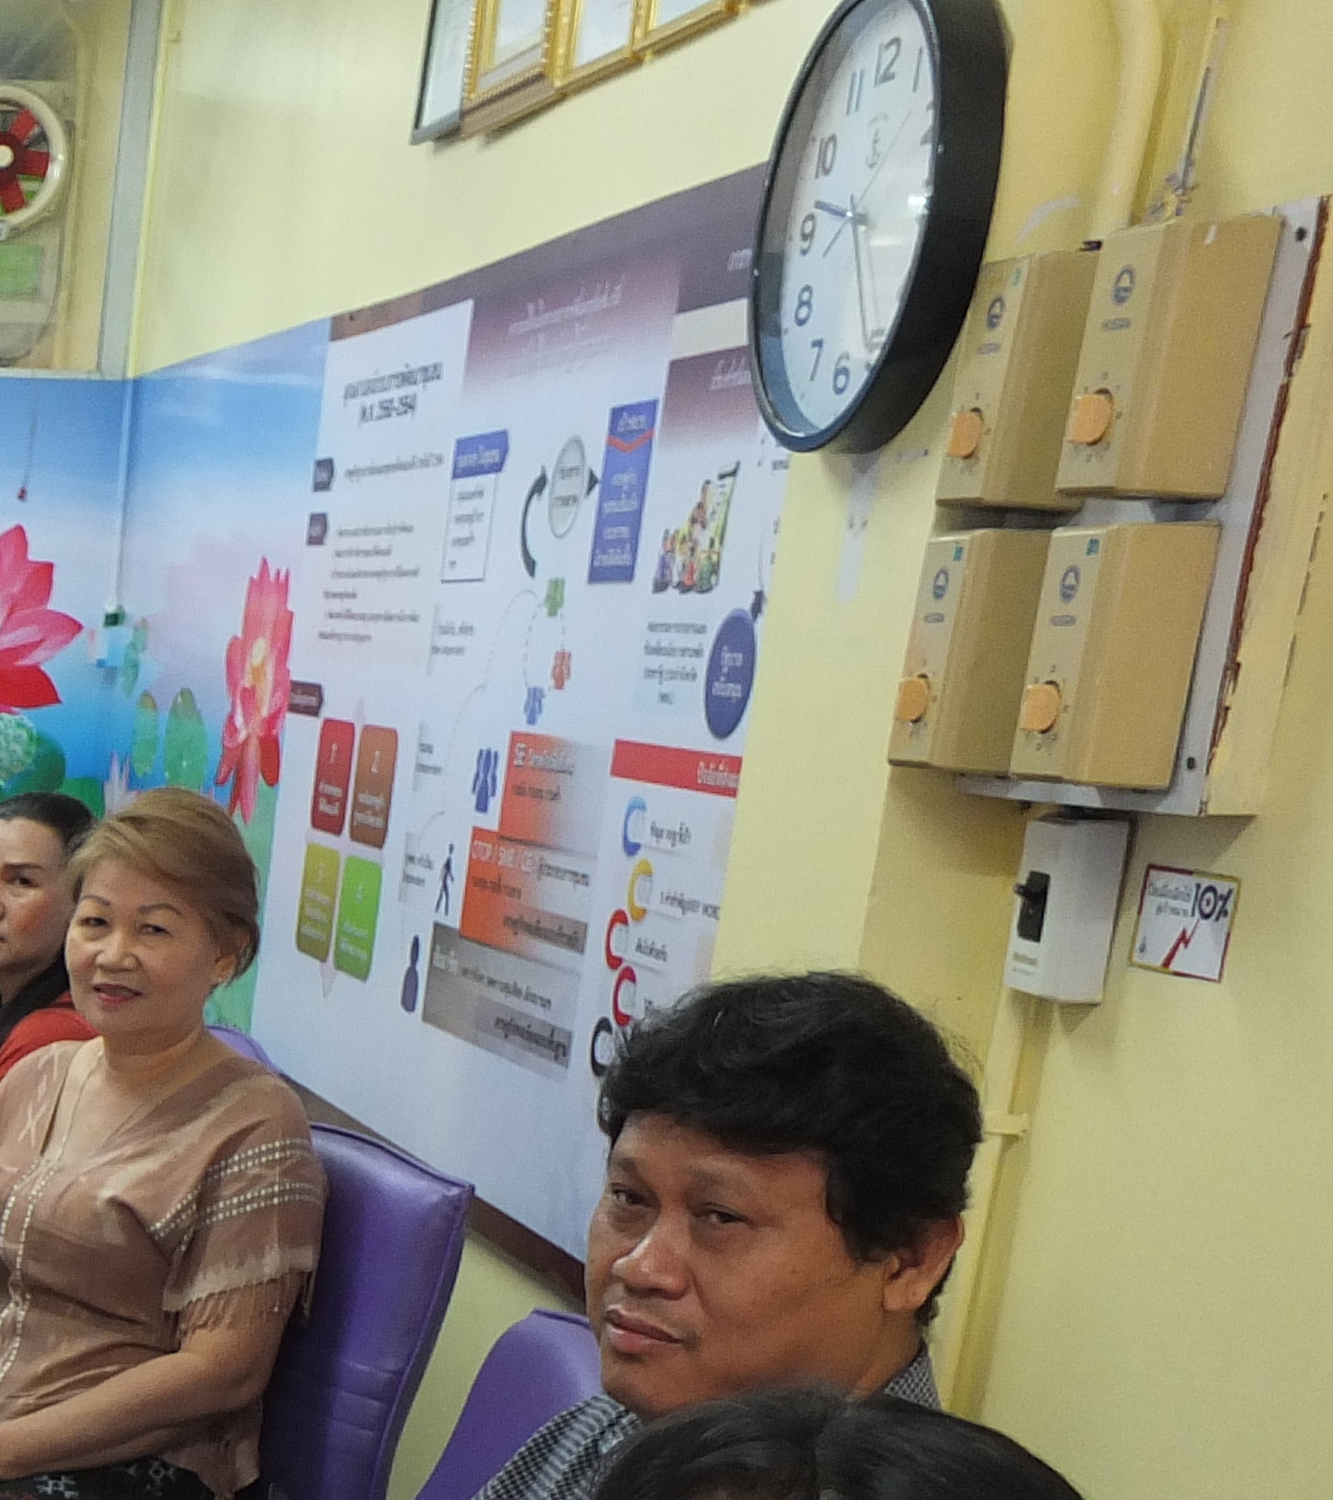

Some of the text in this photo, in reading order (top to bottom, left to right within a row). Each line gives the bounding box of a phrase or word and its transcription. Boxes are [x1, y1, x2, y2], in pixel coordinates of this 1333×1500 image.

[874, 36, 901, 88] 12
[912, 47, 923, 93] 1
[846, 69, 864, 115] 11
[815, 134, 837, 179] 10
[799, 213, 816, 256] 9
[794, 285, 814, 327] 8
[809, 340, 824, 381] 7
[832, 352, 850, 395] 6
